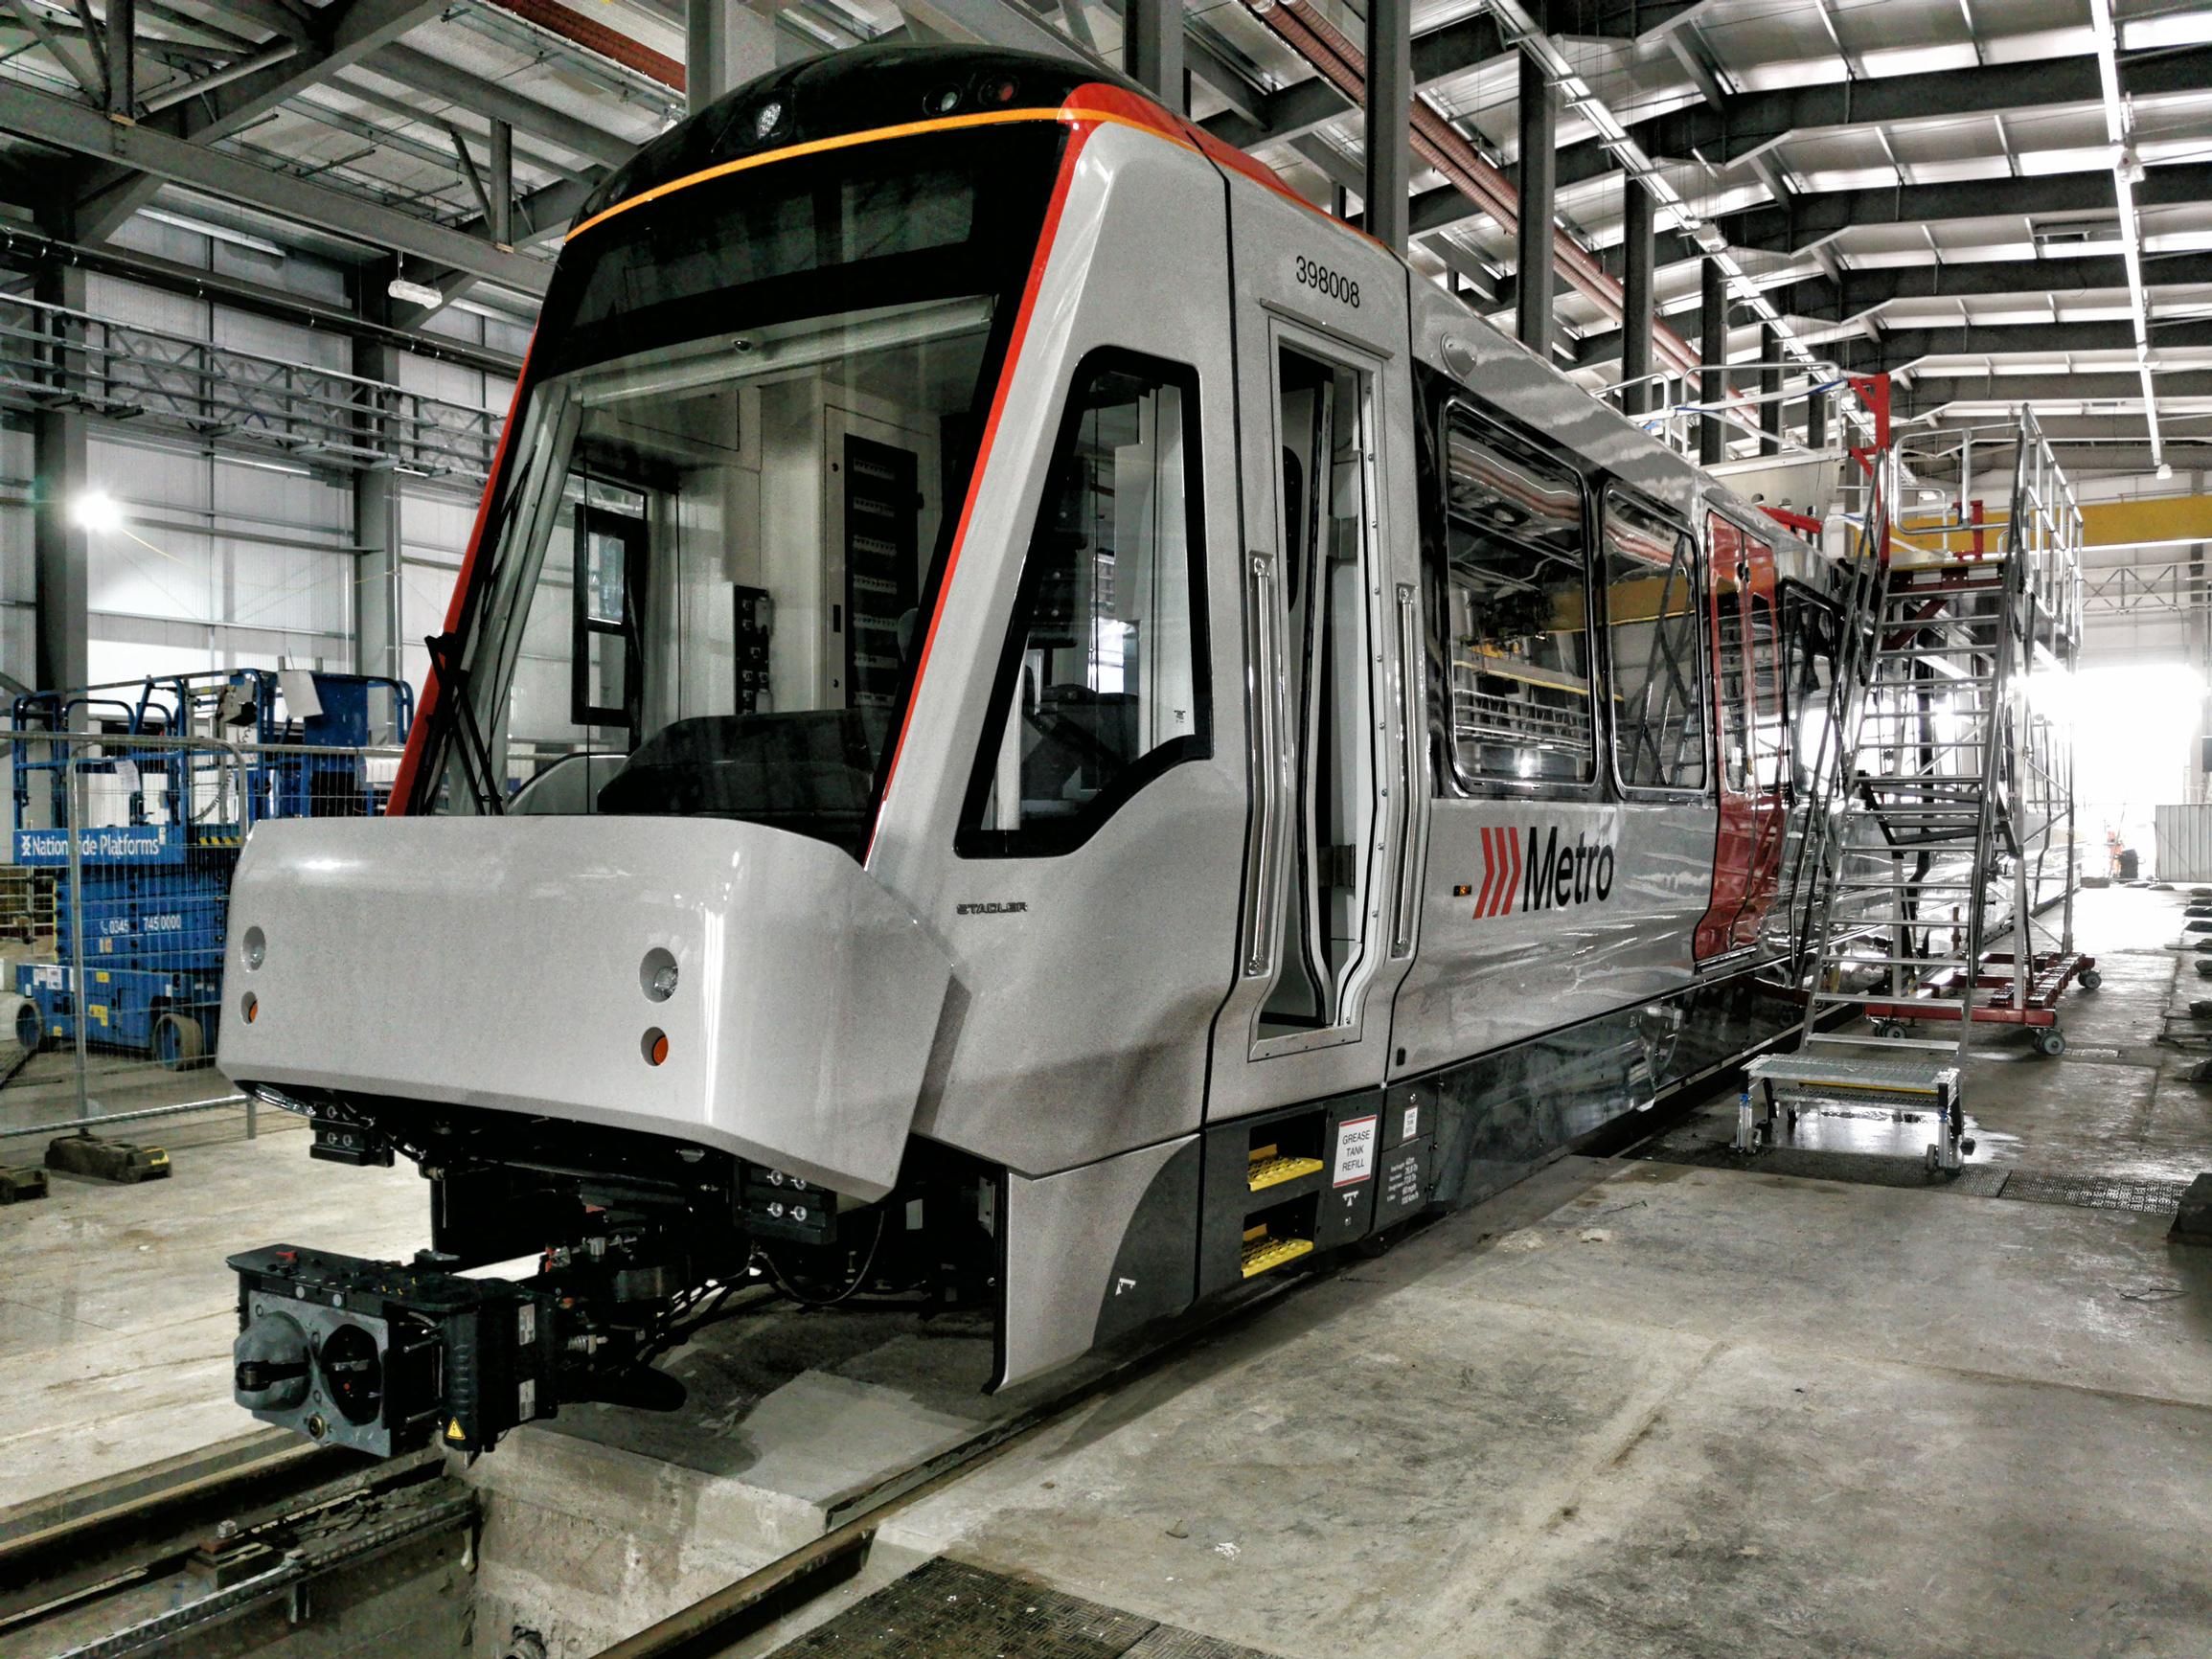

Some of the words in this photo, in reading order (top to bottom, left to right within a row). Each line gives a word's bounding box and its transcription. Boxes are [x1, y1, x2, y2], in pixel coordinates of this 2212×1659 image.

[1296, 255, 1359, 308] 398008
[33, 835, 97, 856] Nationide
[100, 833, 159, 855] Platforms
[1522, 826, 1614, 912] Metro
[956, 901, 1028, 915] STADLER
[109, 919, 129, 935] 0345
[143, 916, 159, 931] 745
[160, 915, 182, 930] 0000
[1342, 1130, 1371, 1146] GREASE
[1346, 1144, 1365, 1157] TANK
[1342, 1158, 1365, 1171] REFILL
